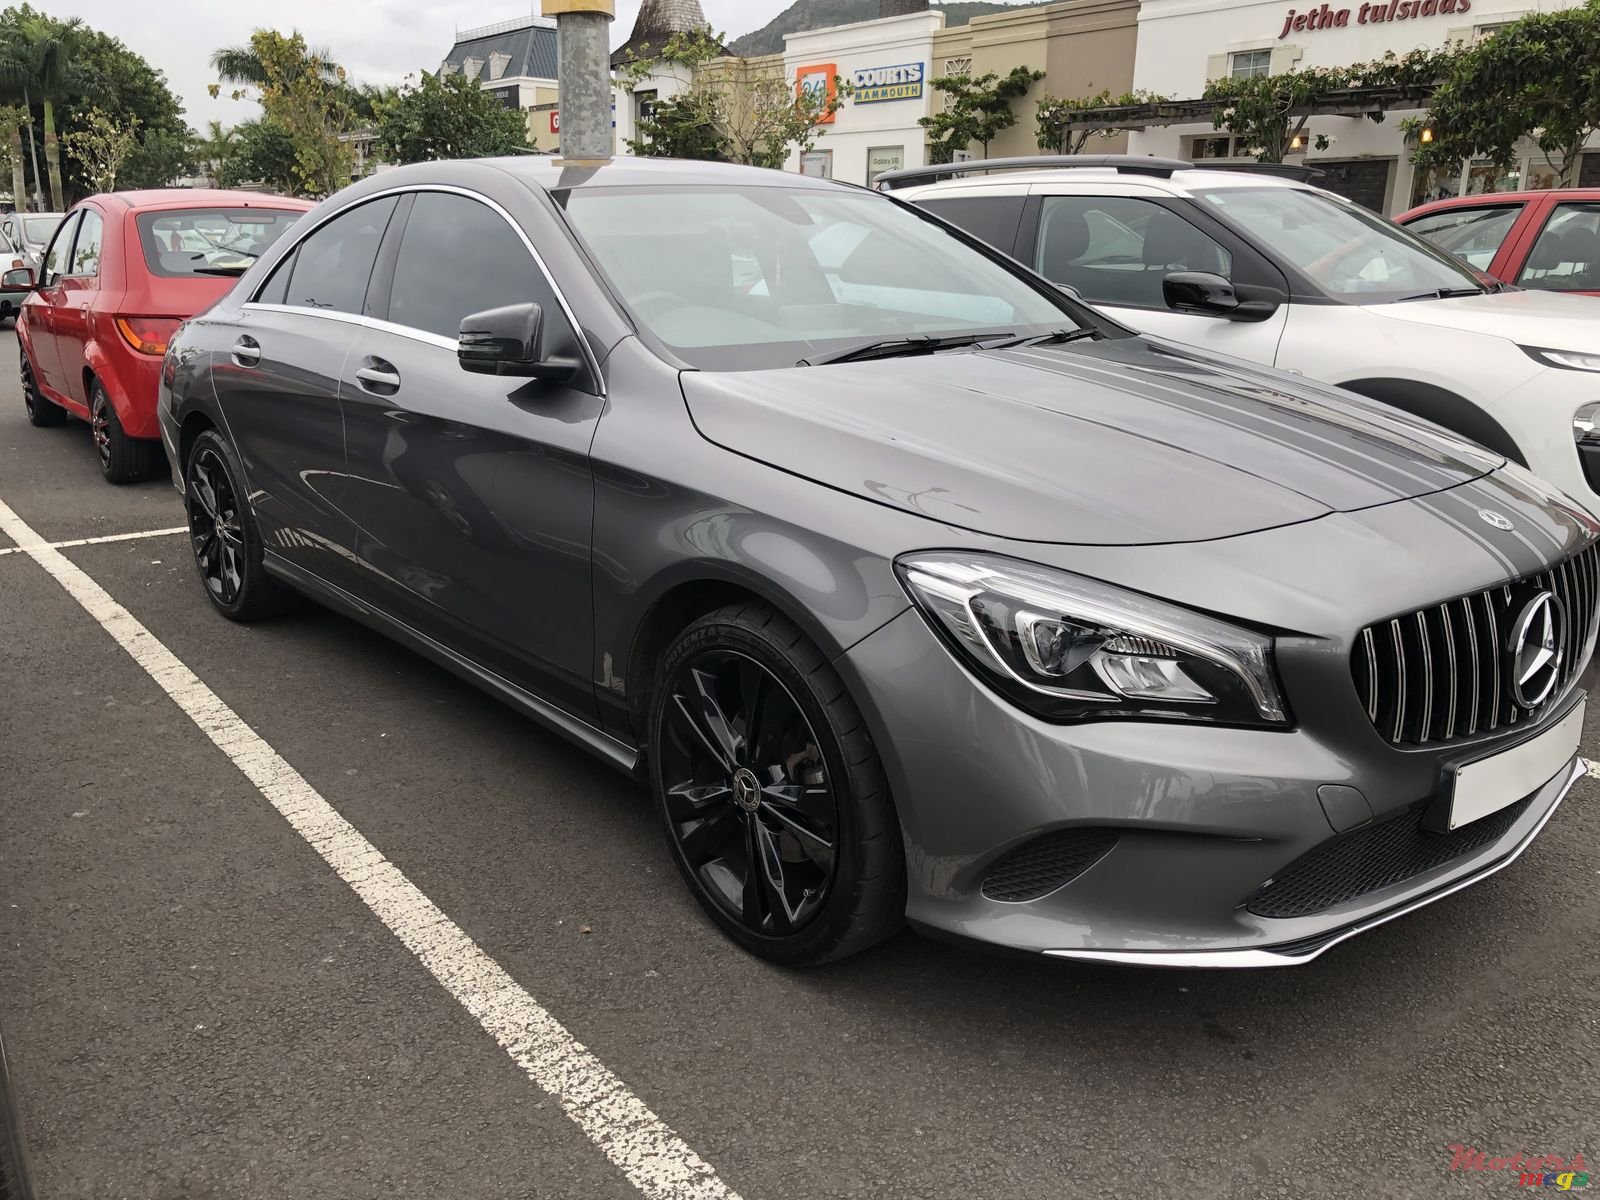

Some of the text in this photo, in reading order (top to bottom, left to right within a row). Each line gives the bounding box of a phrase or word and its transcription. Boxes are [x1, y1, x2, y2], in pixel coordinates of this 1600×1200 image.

[1278, 4, 1351, 40] jetha
[854, 64, 921, 89] COURTS
[854, 85, 919, 100] MAMMOUTH
[873, 157, 891, 166] Galaxy
[665, 627, 717, 672] POTENZA
